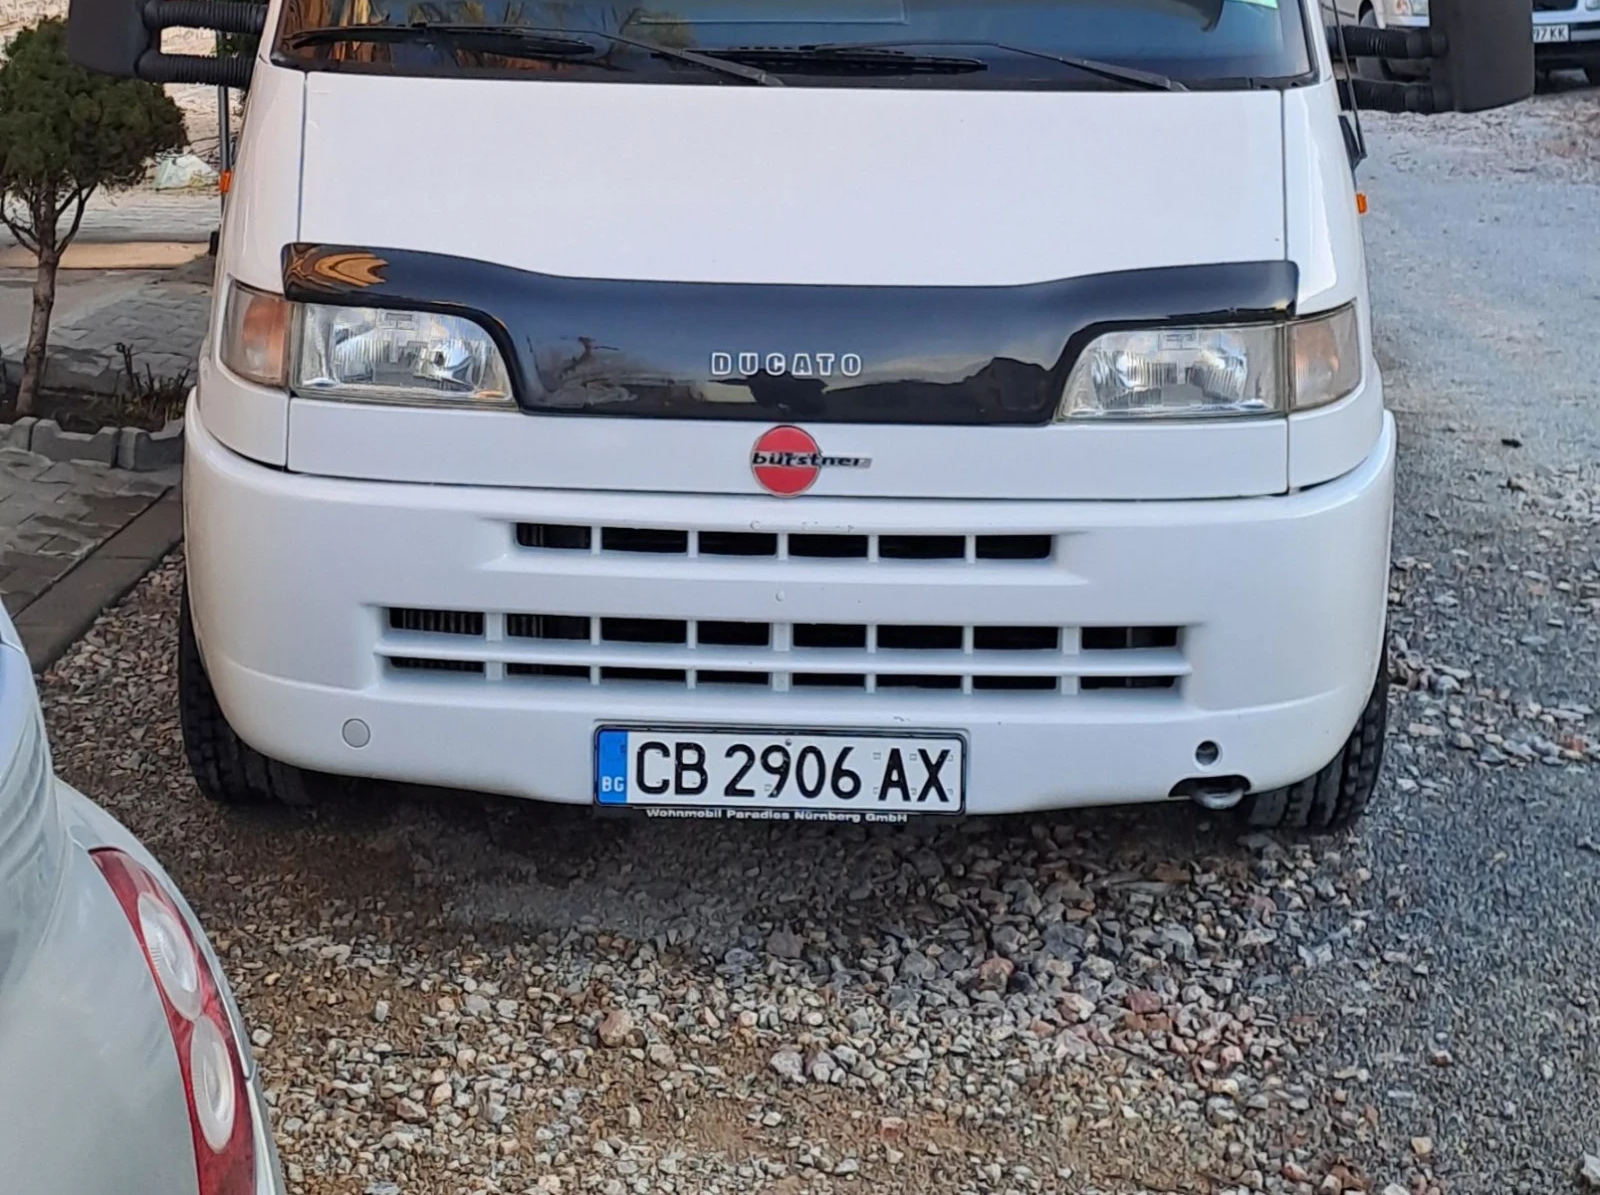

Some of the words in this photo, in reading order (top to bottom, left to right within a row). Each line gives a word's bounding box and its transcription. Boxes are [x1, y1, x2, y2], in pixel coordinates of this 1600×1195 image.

[711, 352, 862, 376] DUCATO
[636, 741, 708, 796] CB
[723, 743, 863, 800] 2906
[878, 747, 951, 803] AX
[602, 776, 625, 793] BG
[646, 809, 722, 819] Wohnmobil
[727, 810, 790, 819] Paradies
[794, 811, 861, 824] Nürnberg
[865, 813, 908, 823] GmbH
